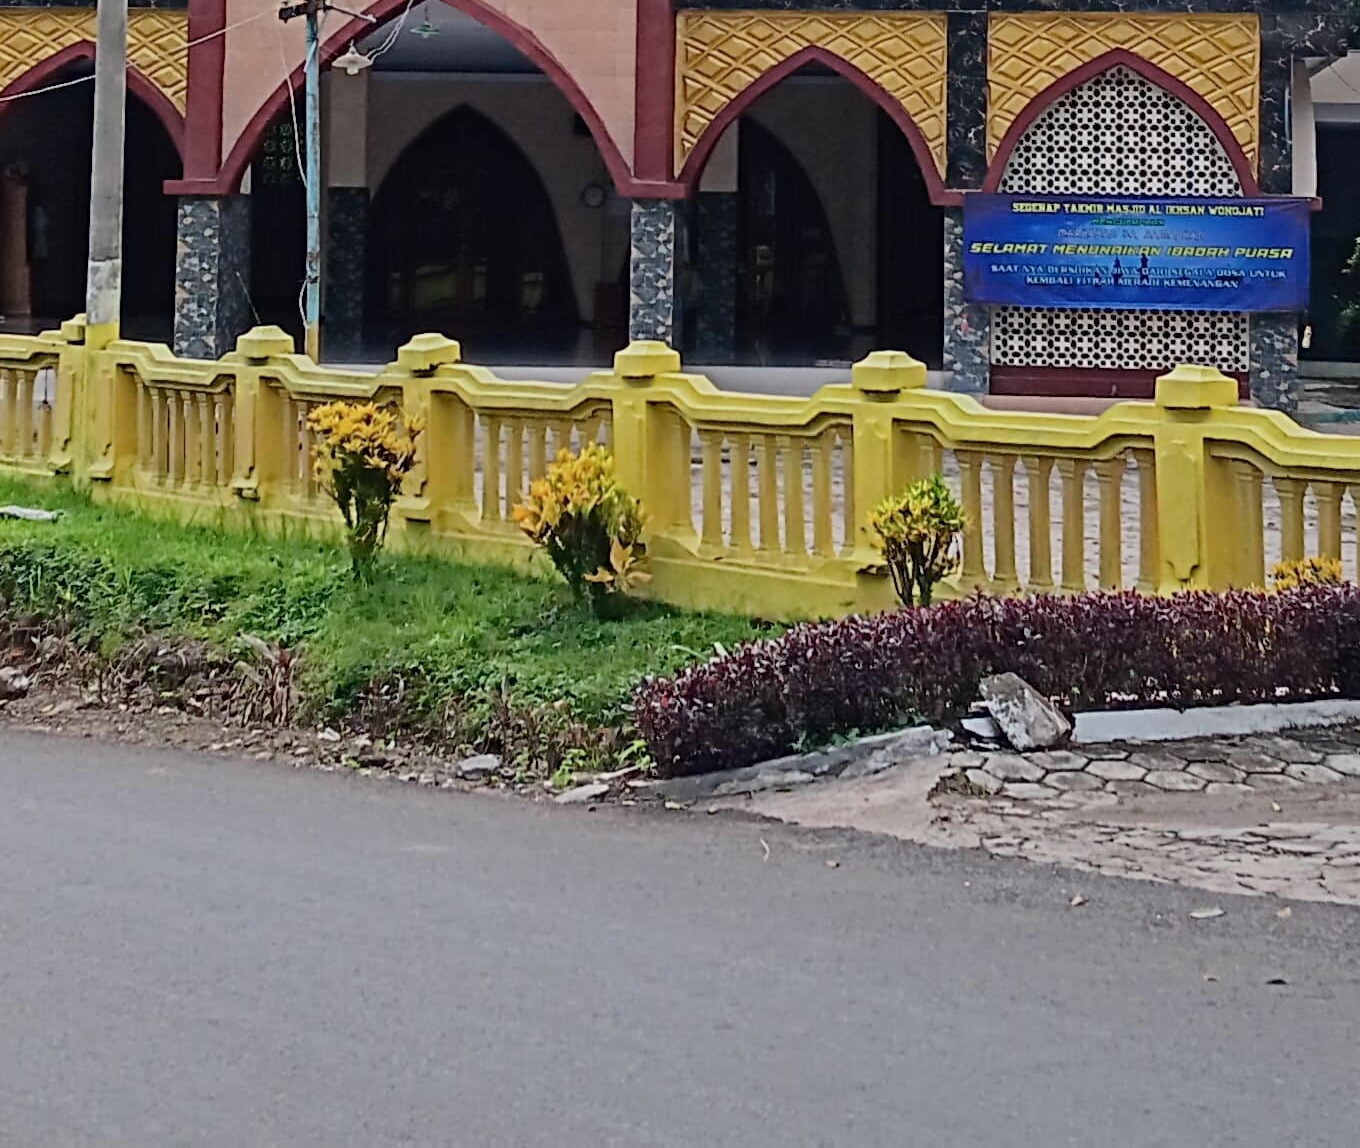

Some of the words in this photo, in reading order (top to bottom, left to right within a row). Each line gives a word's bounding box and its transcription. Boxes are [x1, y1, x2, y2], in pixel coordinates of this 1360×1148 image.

[1106, 203, 1146, 214] MASJID
[1149, 204, 1162, 215] AL
[970, 243, 1049, 254] SELAMAT
[1052, 244, 1162, 256] MENUNAIKAN
[1166, 246, 1230, 258] IBADAH
[1234, 248, 1294, 259] PUASA
[990, 264, 1018, 273] SAAT
[1249, 269, 1287, 278] UNTUK
[1026, 275, 1074, 285] KEMBALI
